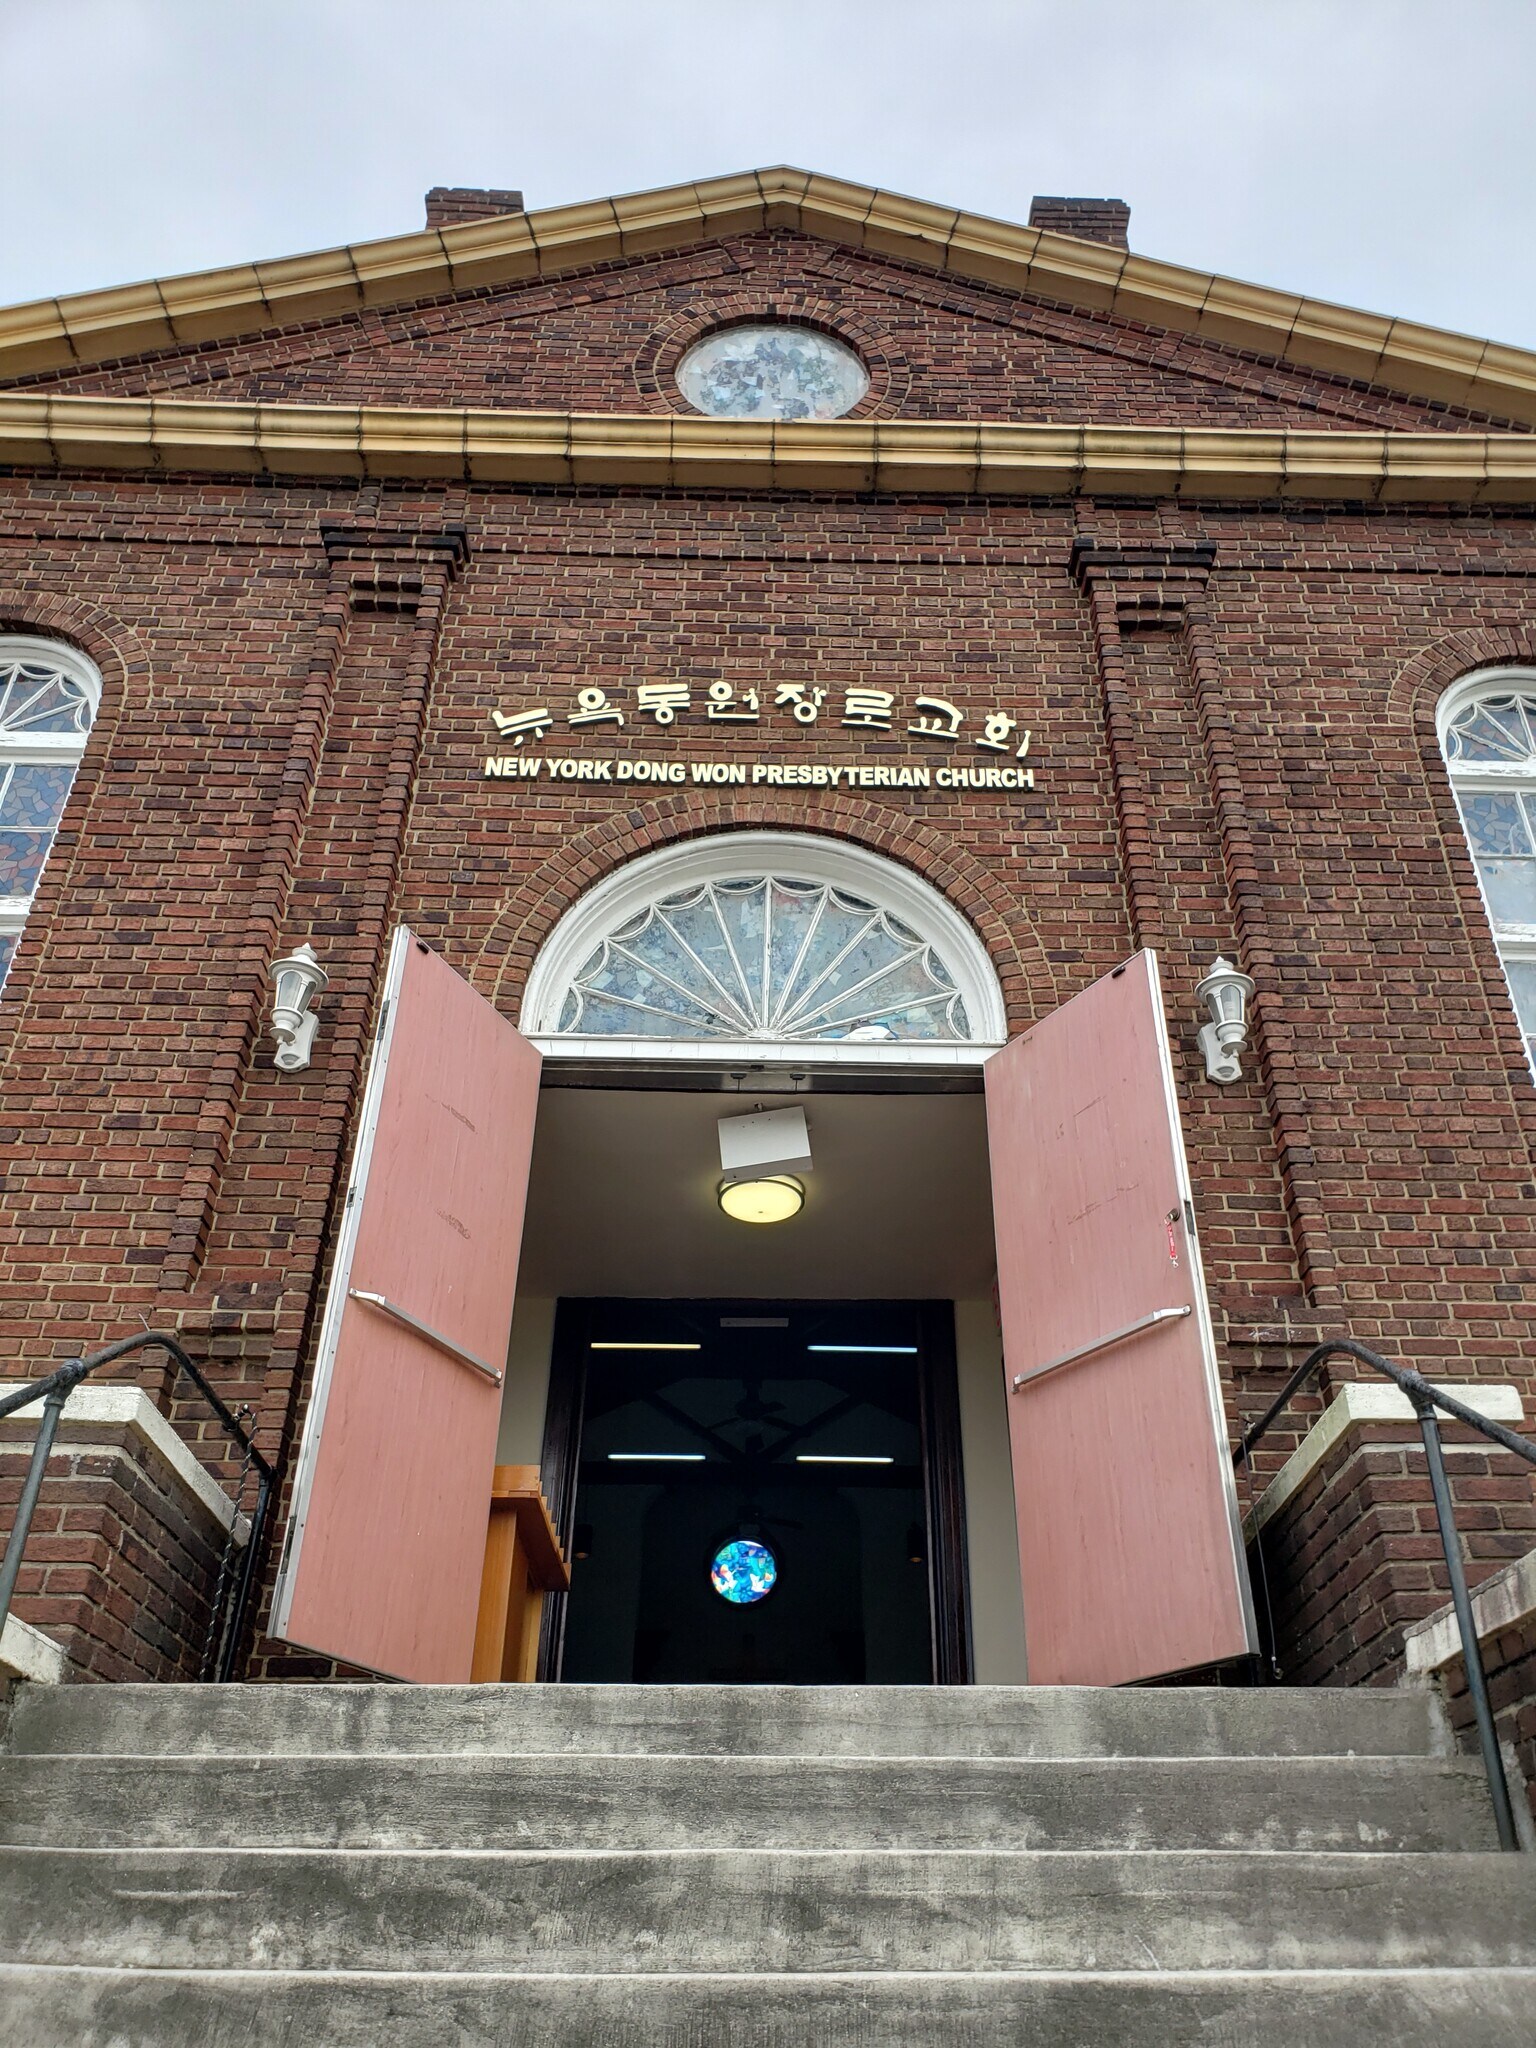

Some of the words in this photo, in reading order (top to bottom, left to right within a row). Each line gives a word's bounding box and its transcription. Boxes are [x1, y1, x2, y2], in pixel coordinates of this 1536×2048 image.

[484, 756, 543, 777] NEW
[545, 758, 613, 780] YORK
[616, 760, 686, 783] DONG
[691, 763, 746, 784] WON
[752, 764, 931, 787] PRESBYTERIAN
[935, 767, 1035, 788] CHURCH
